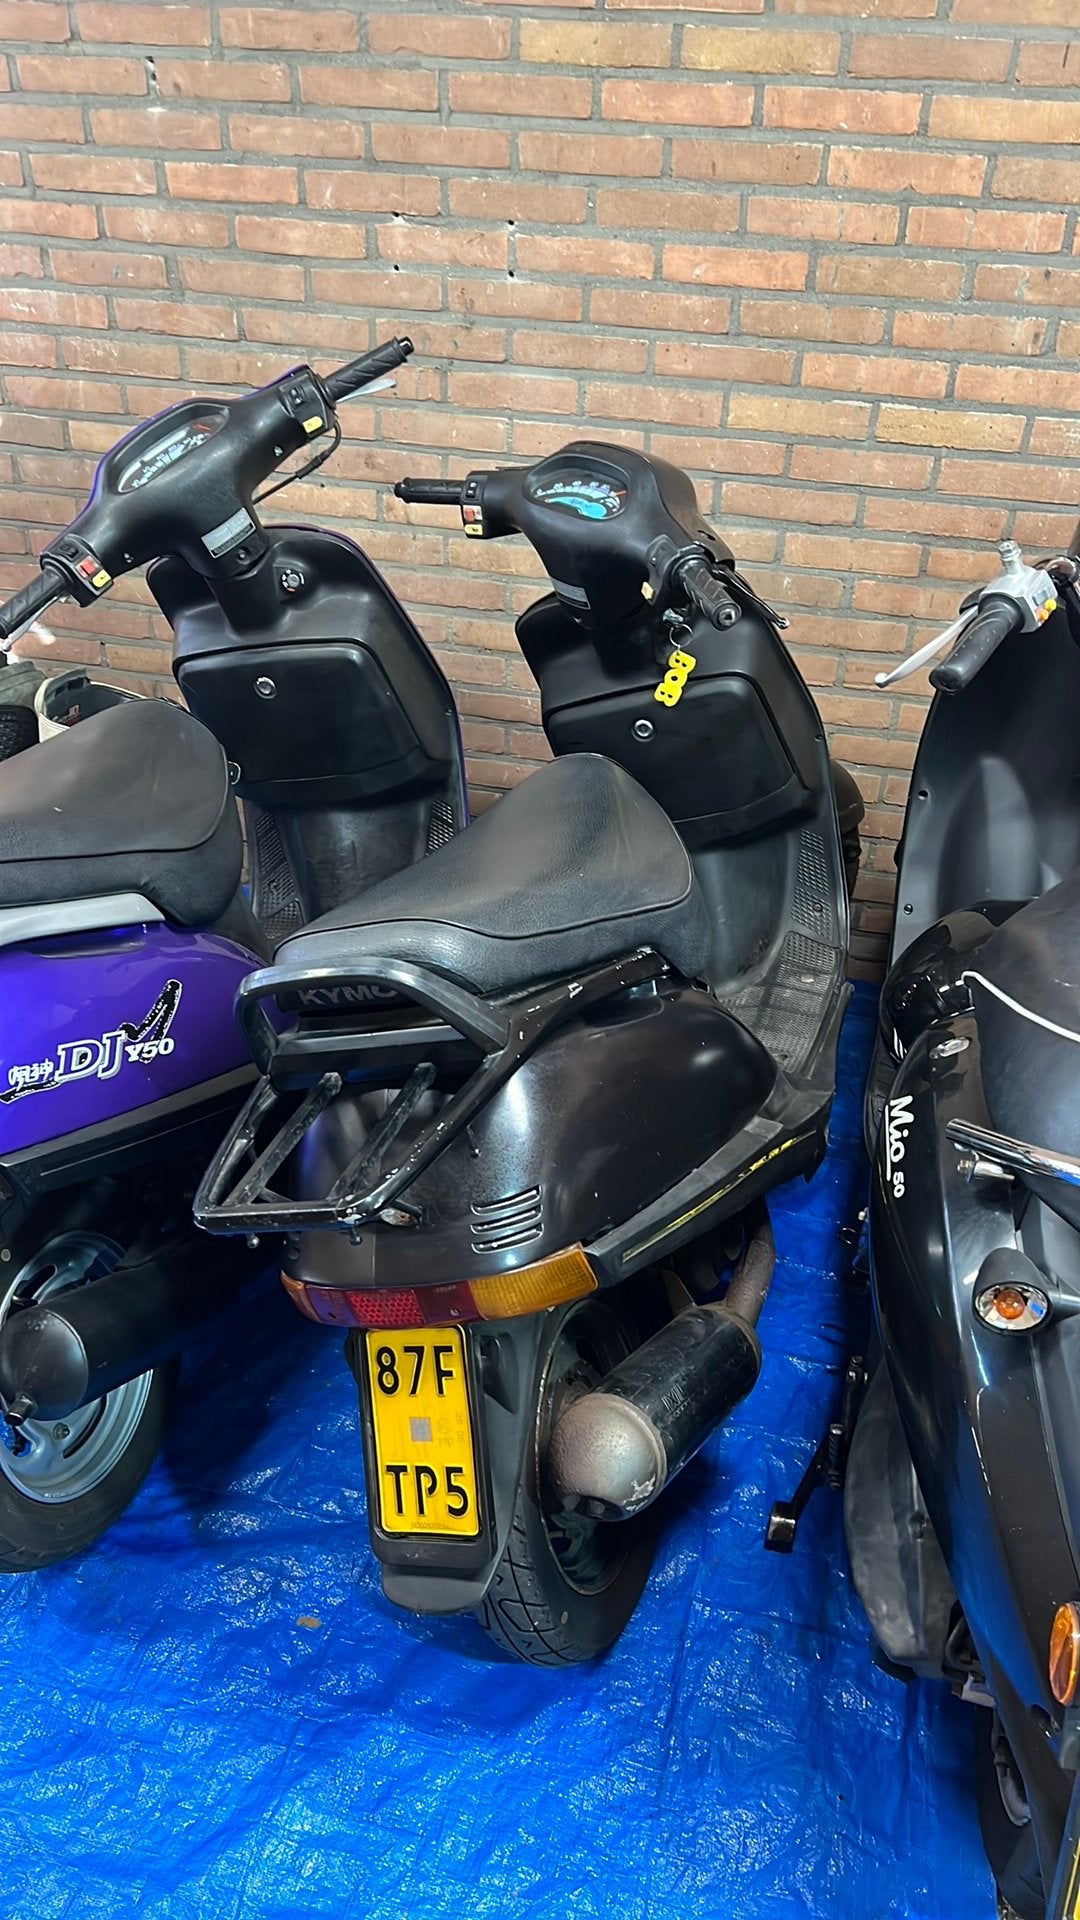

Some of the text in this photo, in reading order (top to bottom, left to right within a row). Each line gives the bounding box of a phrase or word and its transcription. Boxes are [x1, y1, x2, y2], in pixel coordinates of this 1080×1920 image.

[298, 985, 398, 1005] KYMC
[54, 1030, 175, 1080] DJ Y50
[889, 1095, 915, 1198] Mio 50
[376, 1345, 454, 1396] 87F
[385, 1464, 469, 1517] TP5
